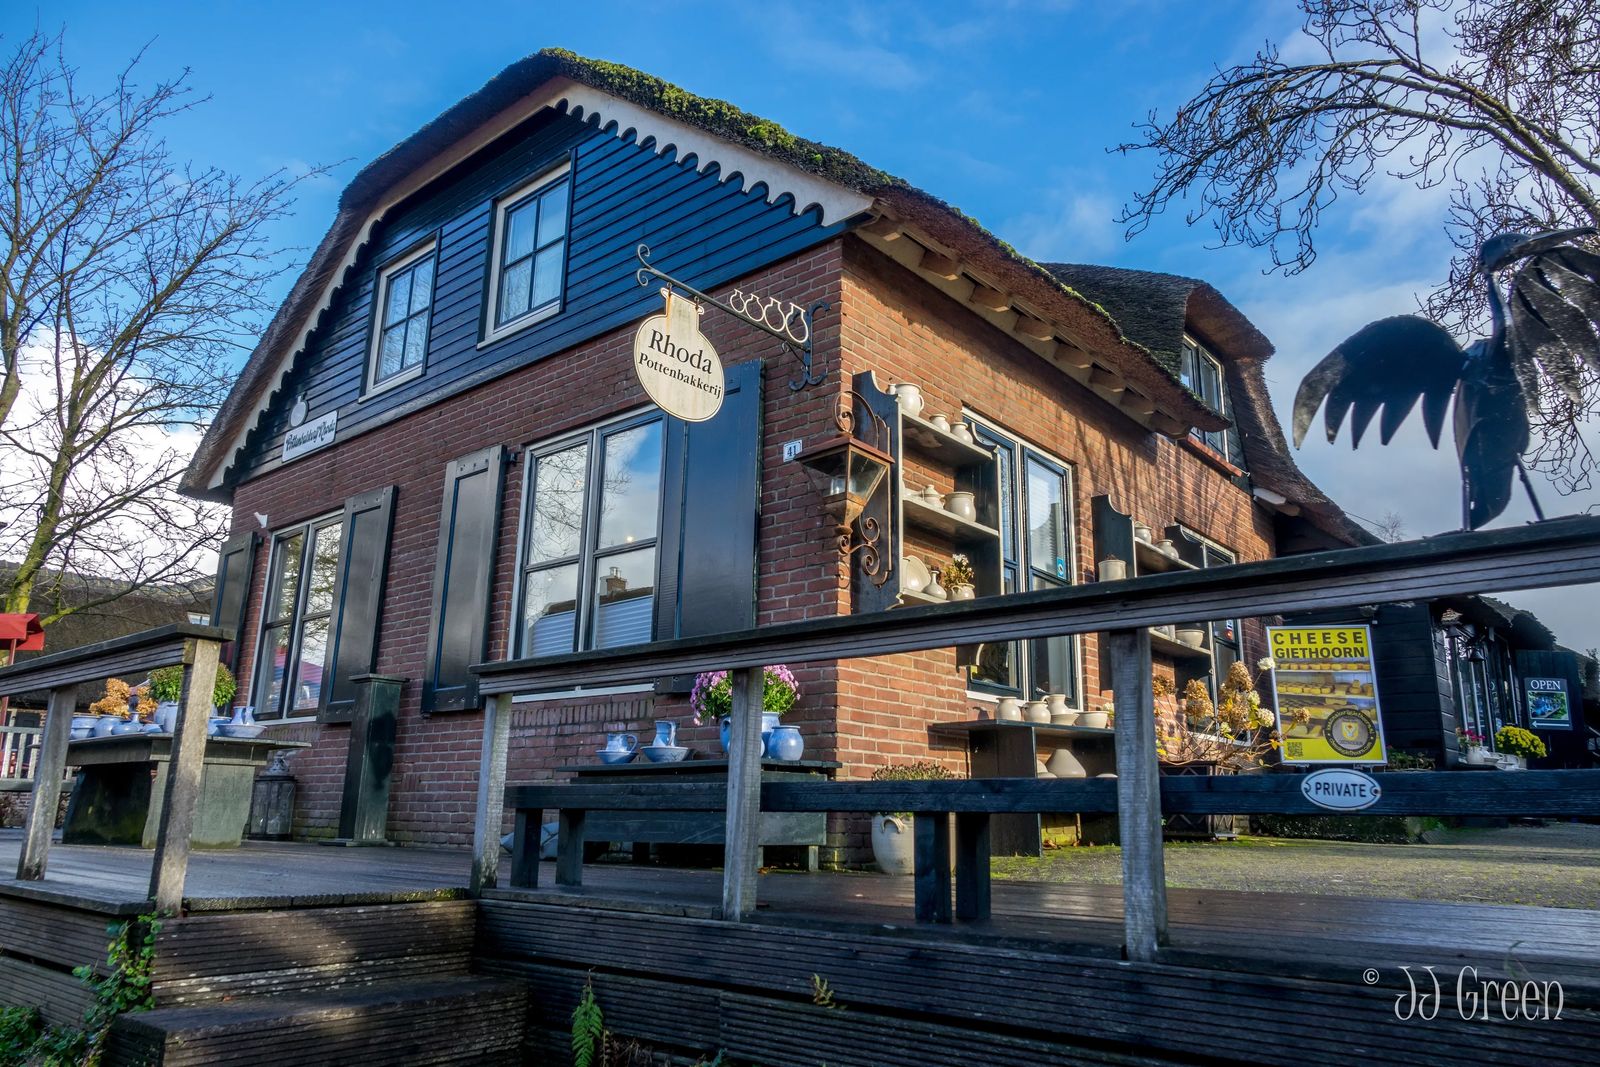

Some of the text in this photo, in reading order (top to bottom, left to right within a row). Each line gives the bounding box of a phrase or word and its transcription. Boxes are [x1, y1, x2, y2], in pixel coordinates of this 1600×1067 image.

[648, 329, 712, 374] Rhoda
[638, 352, 722, 399] Pottenbakkerij
[787, 445, 796, 456] 41
[1273, 631, 1364, 645] CHEESE
[1274, 646, 1365, 659] GIETHOORN
[1530, 679, 1561, 691] OPEN
[1315, 782, 1367, 798] PRIVATE
